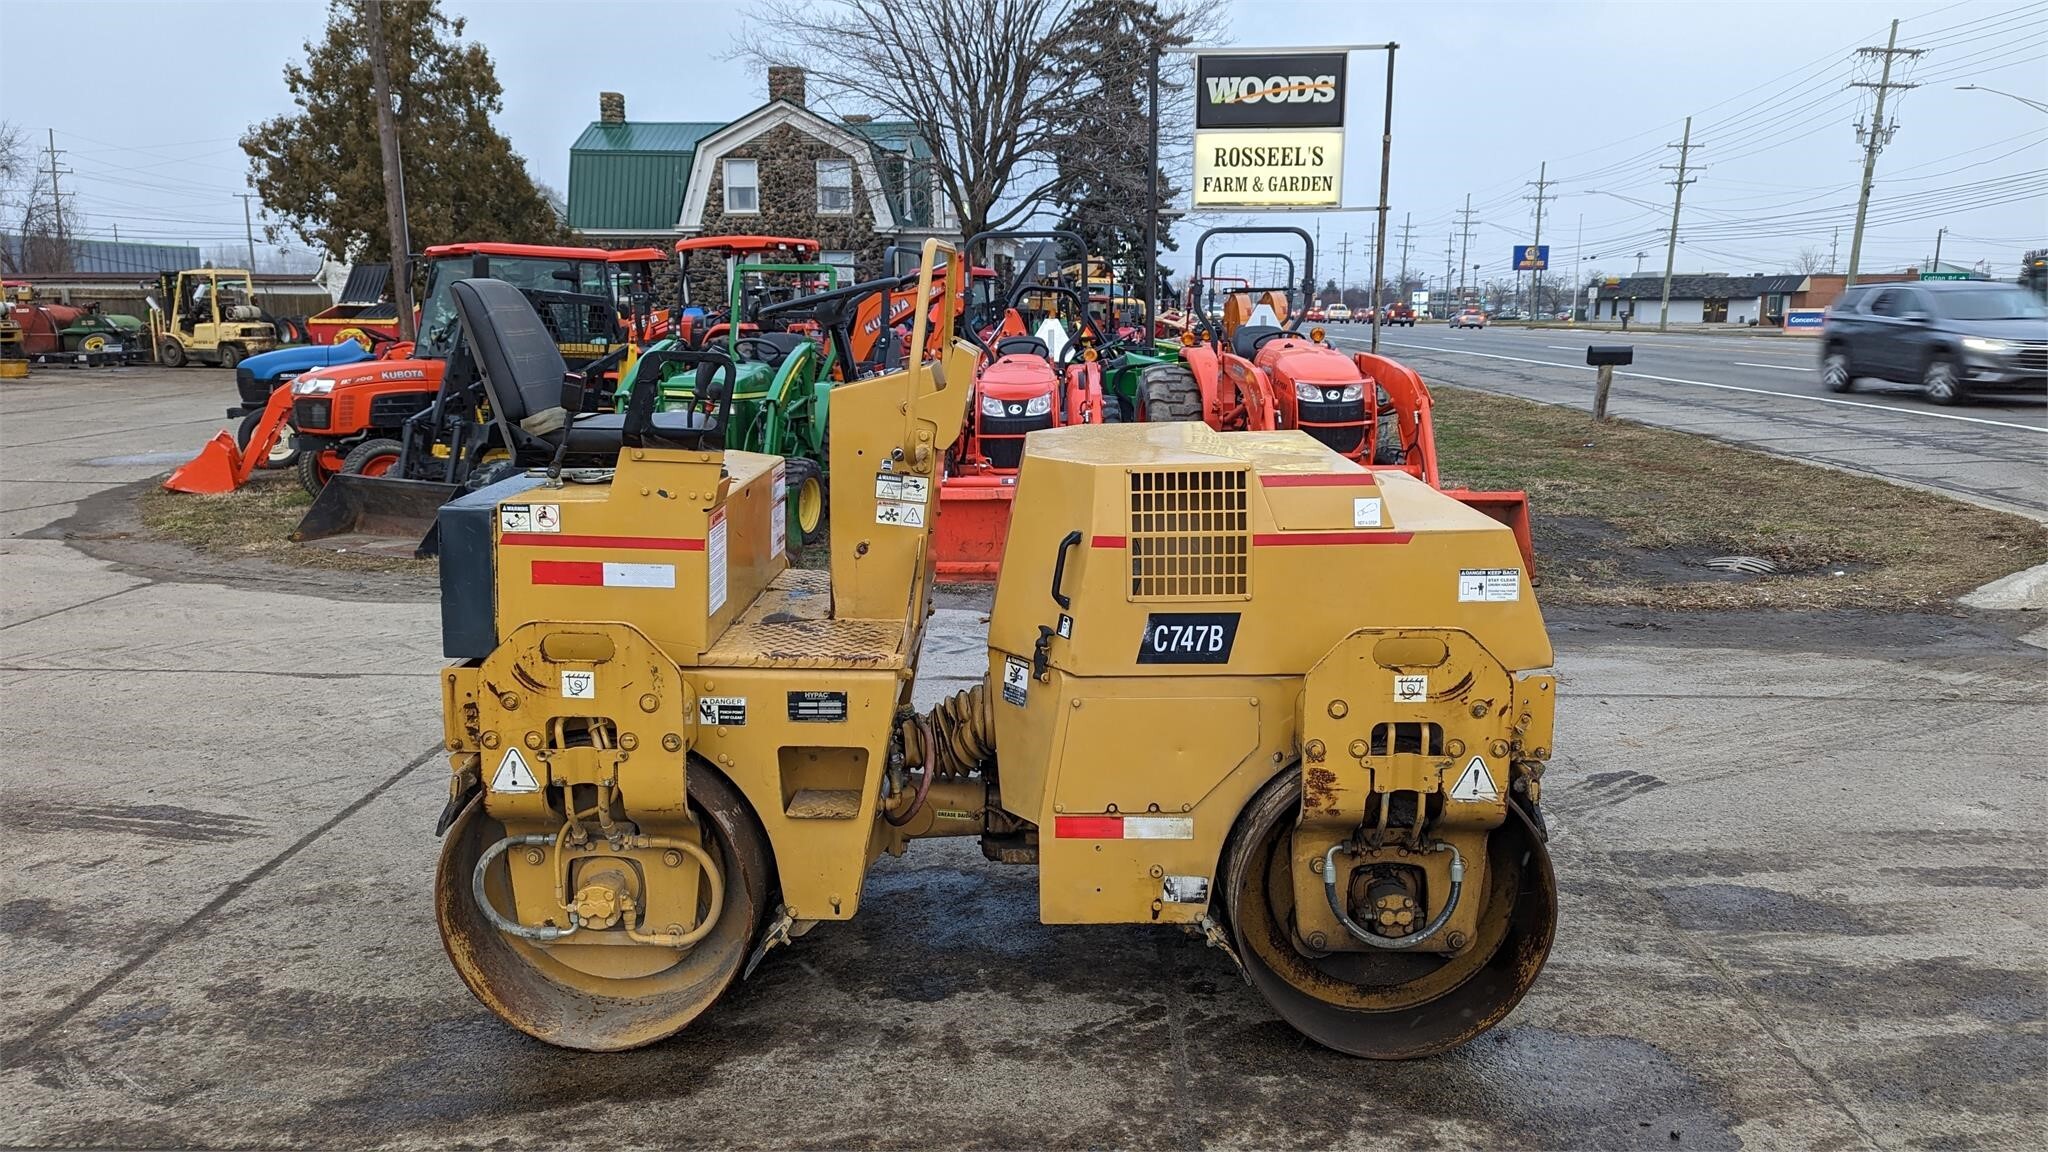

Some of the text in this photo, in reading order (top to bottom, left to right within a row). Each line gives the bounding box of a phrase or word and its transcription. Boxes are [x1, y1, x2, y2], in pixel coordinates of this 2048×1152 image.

[1206, 75, 1336, 104] WOODS
[1213, 146, 1324, 168] ROSSEEL'S
[1202, 175, 1333, 193] FARM & GARDEN
[381, 369, 424, 380] KUBOTA
[1153, 624, 1224, 653] C747B
